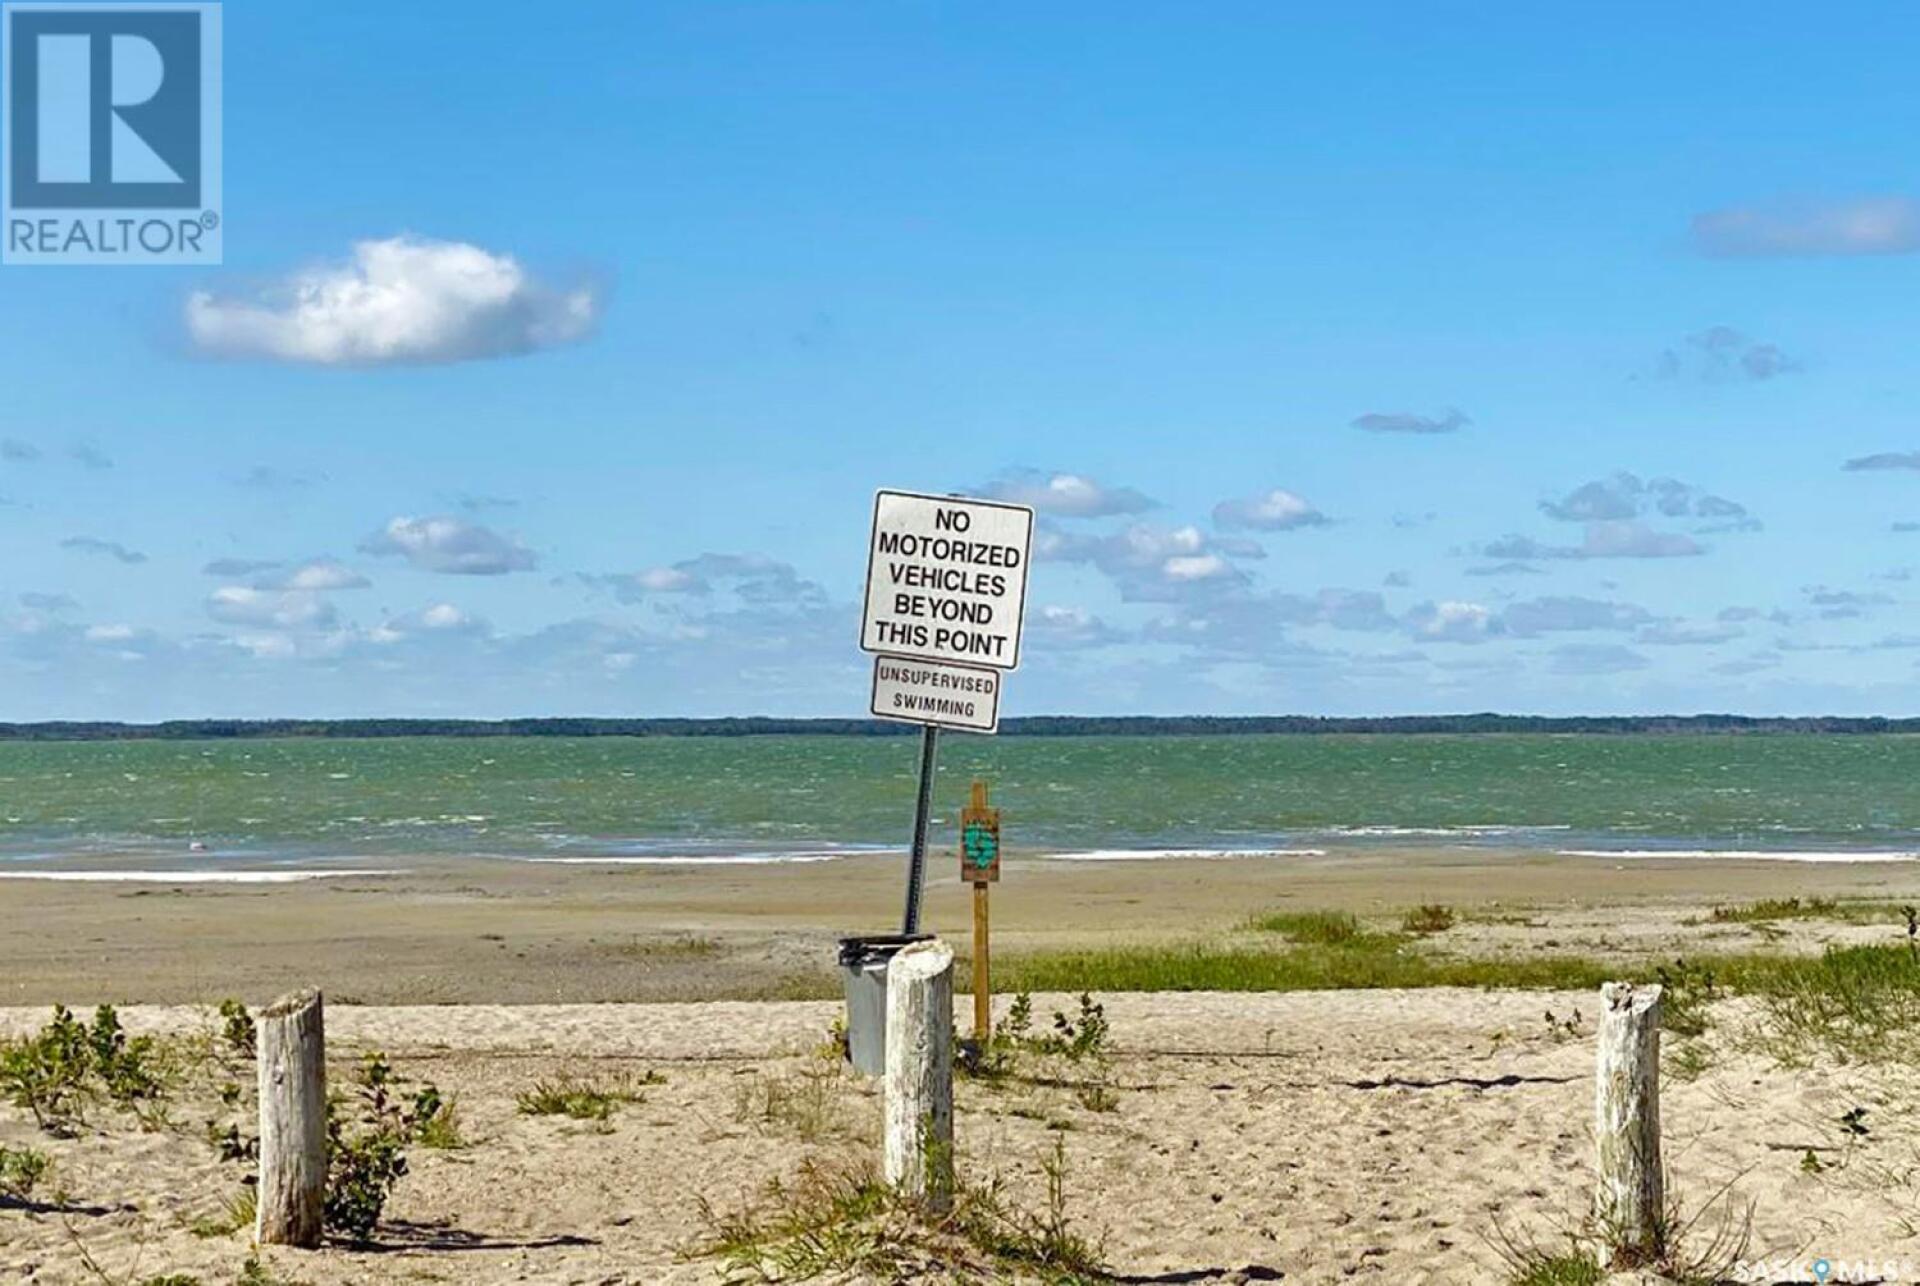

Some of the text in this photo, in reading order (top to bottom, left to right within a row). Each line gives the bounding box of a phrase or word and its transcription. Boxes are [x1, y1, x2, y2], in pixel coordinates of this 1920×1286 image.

[936, 508, 970, 532] NO
[879, 532, 1020, 568] MOTORIZED
[890, 563, 1005, 597] VEHICLES
[894, 594, 992, 624] BEYOND
[875, 621, 1007, 657] THIS POINT
[880, 666, 993, 694] UNSUPERVISED
[893, 693, 974, 717] SWIMMING
